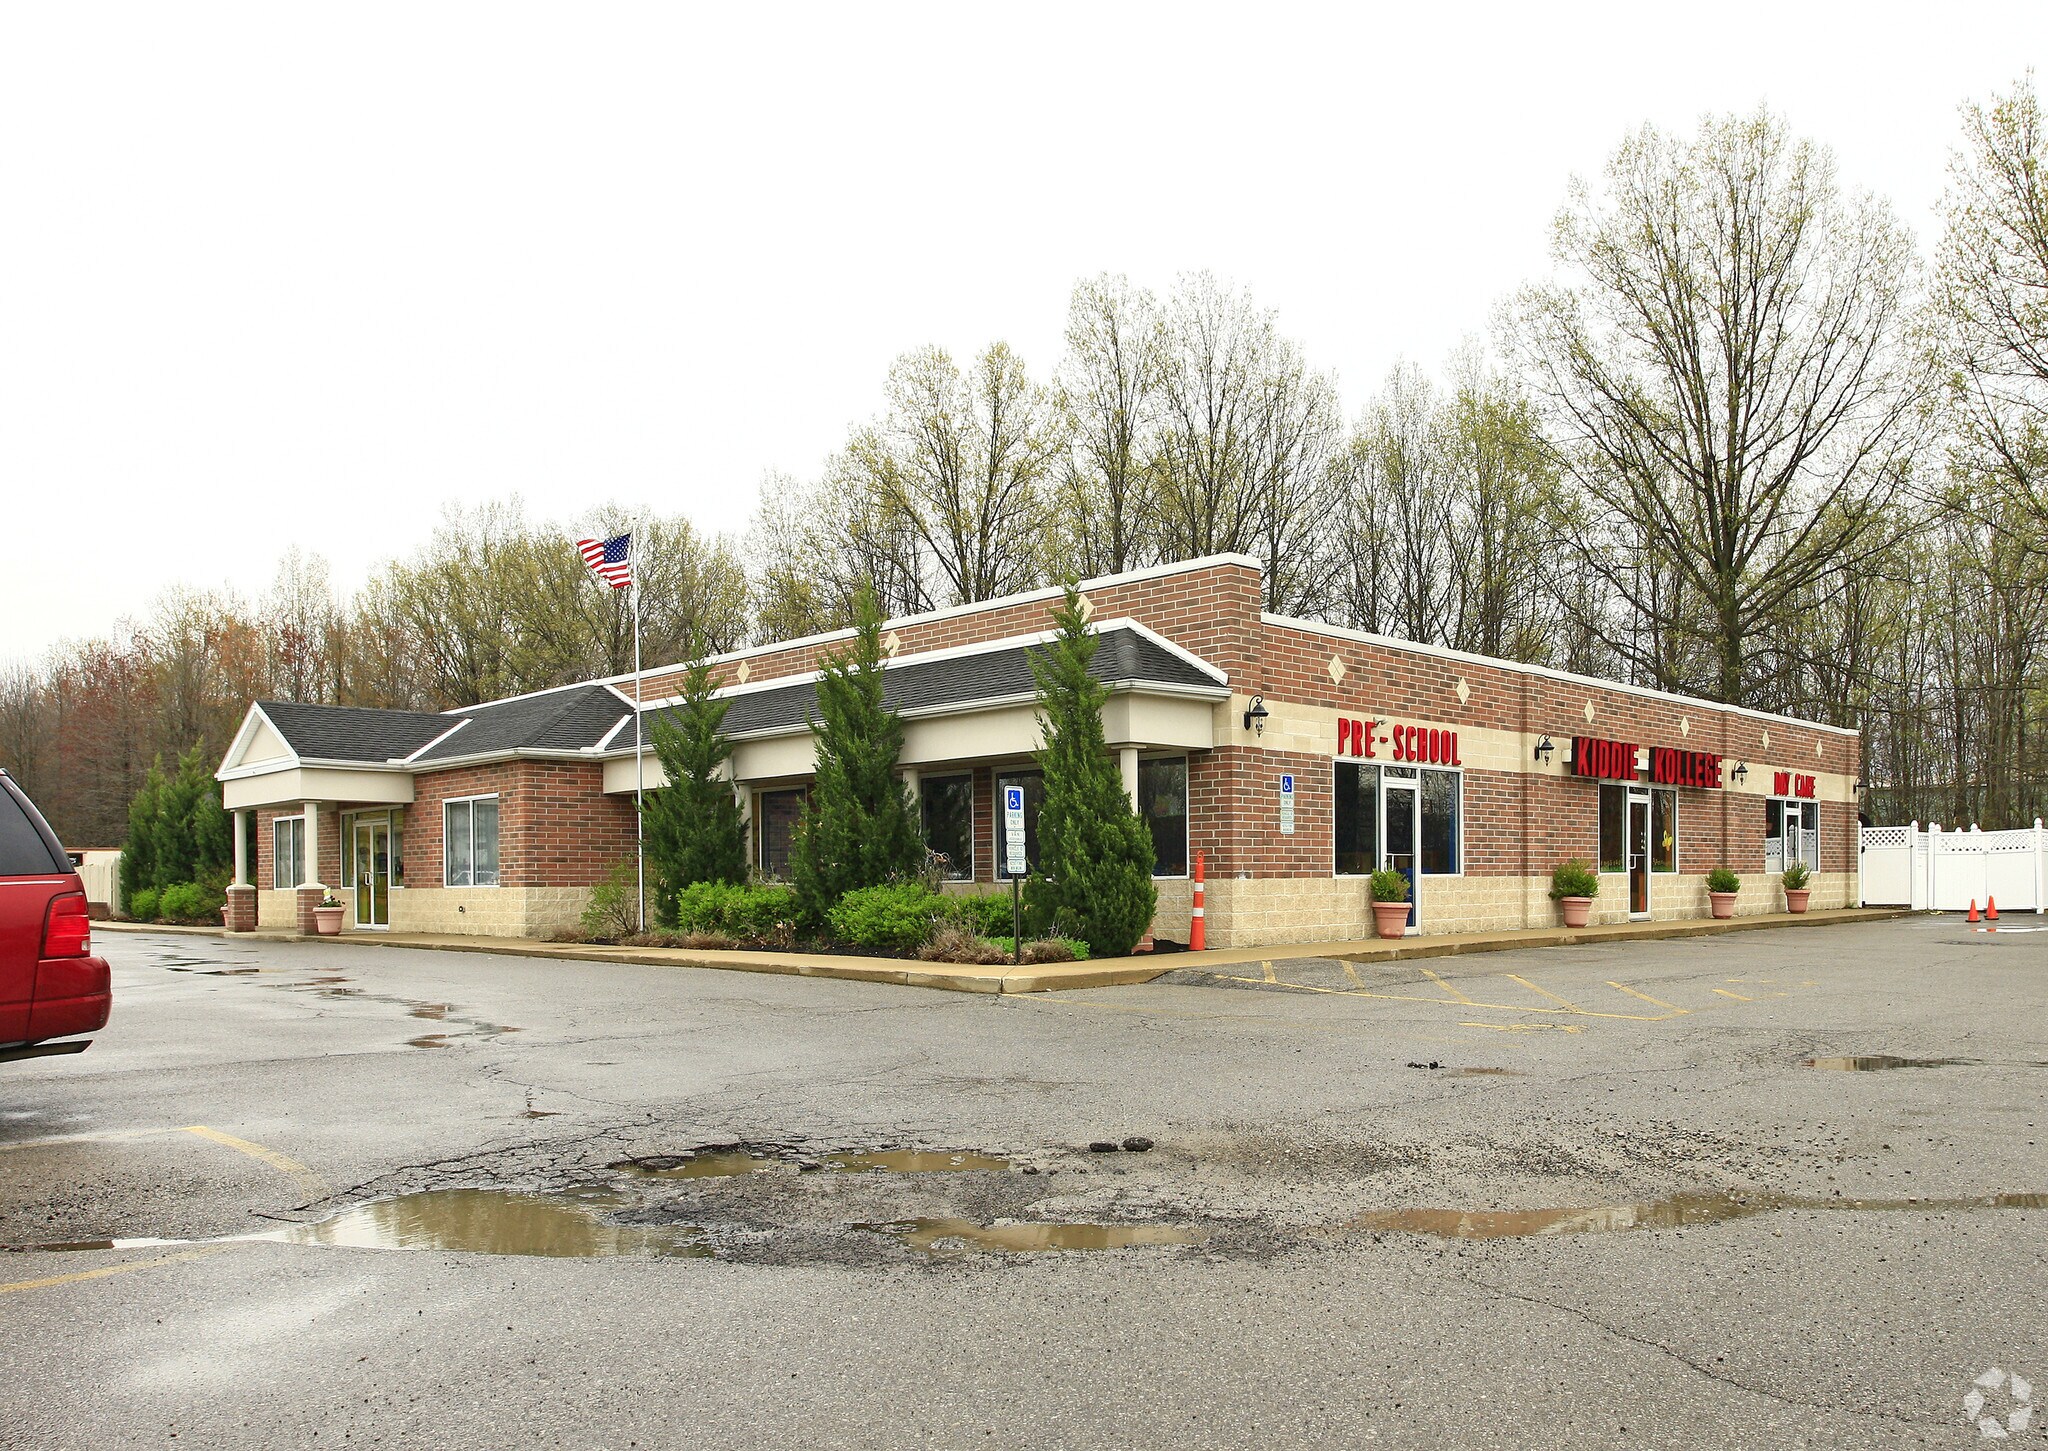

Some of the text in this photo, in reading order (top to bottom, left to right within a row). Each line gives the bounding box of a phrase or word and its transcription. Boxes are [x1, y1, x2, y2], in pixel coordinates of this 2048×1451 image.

[1576, 736, 1723, 788] KIDDIE KOLLEGE
[1795, 773, 1816, 799] CARE
